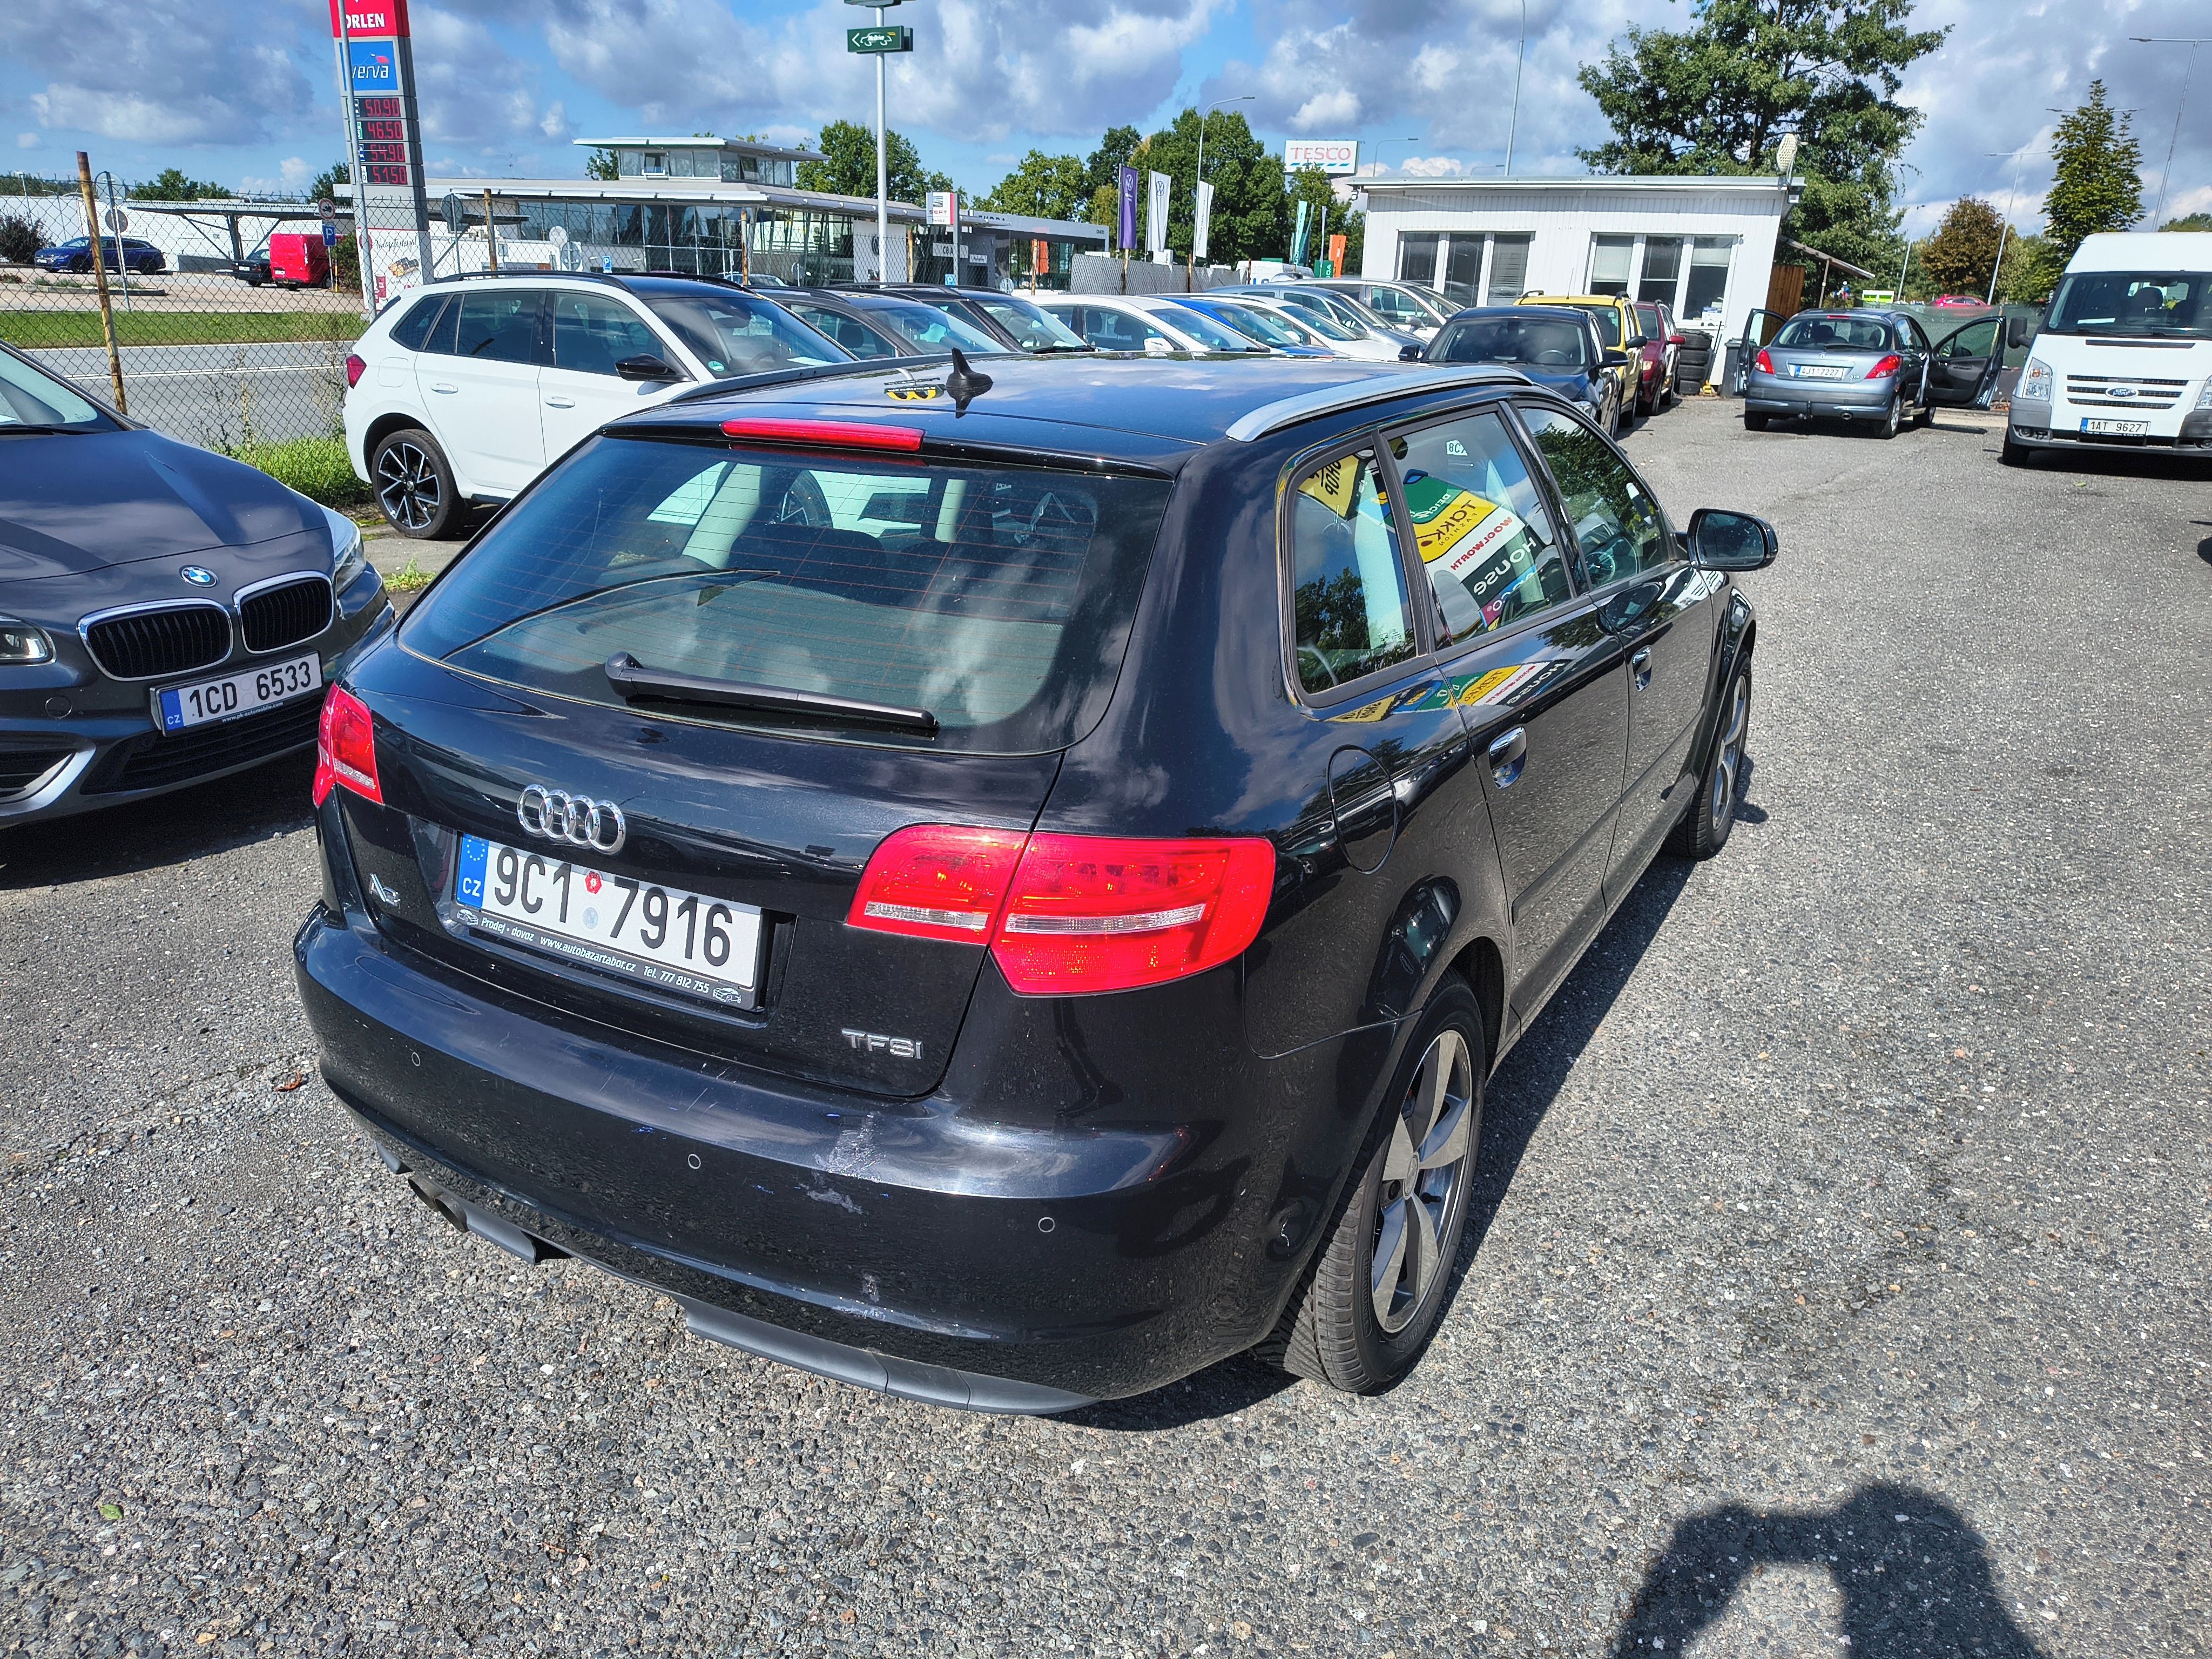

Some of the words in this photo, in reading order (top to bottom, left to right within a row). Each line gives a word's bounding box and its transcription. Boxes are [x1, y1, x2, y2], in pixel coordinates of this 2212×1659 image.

[1291, 147, 1351, 160] TESCO
[326, 228, 333, 239] P
[2090, 421, 2108, 430] 1AT
[2116, 423, 2142, 433] 9627
[190, 682, 238, 718] 1CD
[256, 661, 311, 700] 6533
[167, 714, 181, 725] CZ
[222, 702, 284, 723] www.pk-automobile.com
[462, 877, 482, 897] CZ
[494, 847, 572, 923] 9C1
[610, 876, 733, 967] 7916
[481, 917, 506, 934] Prodej
[511, 927, 535, 941] dovoz
[540, 936, 637, 972] www.autobazartabor.cz
[643, 966, 657, 979] Tel.
[659, 970, 676, 983] 777
[676, 976, 692, 989] 812
[692, 980, 710, 994] 755
[841, 1028, 922, 1060] TFSI
